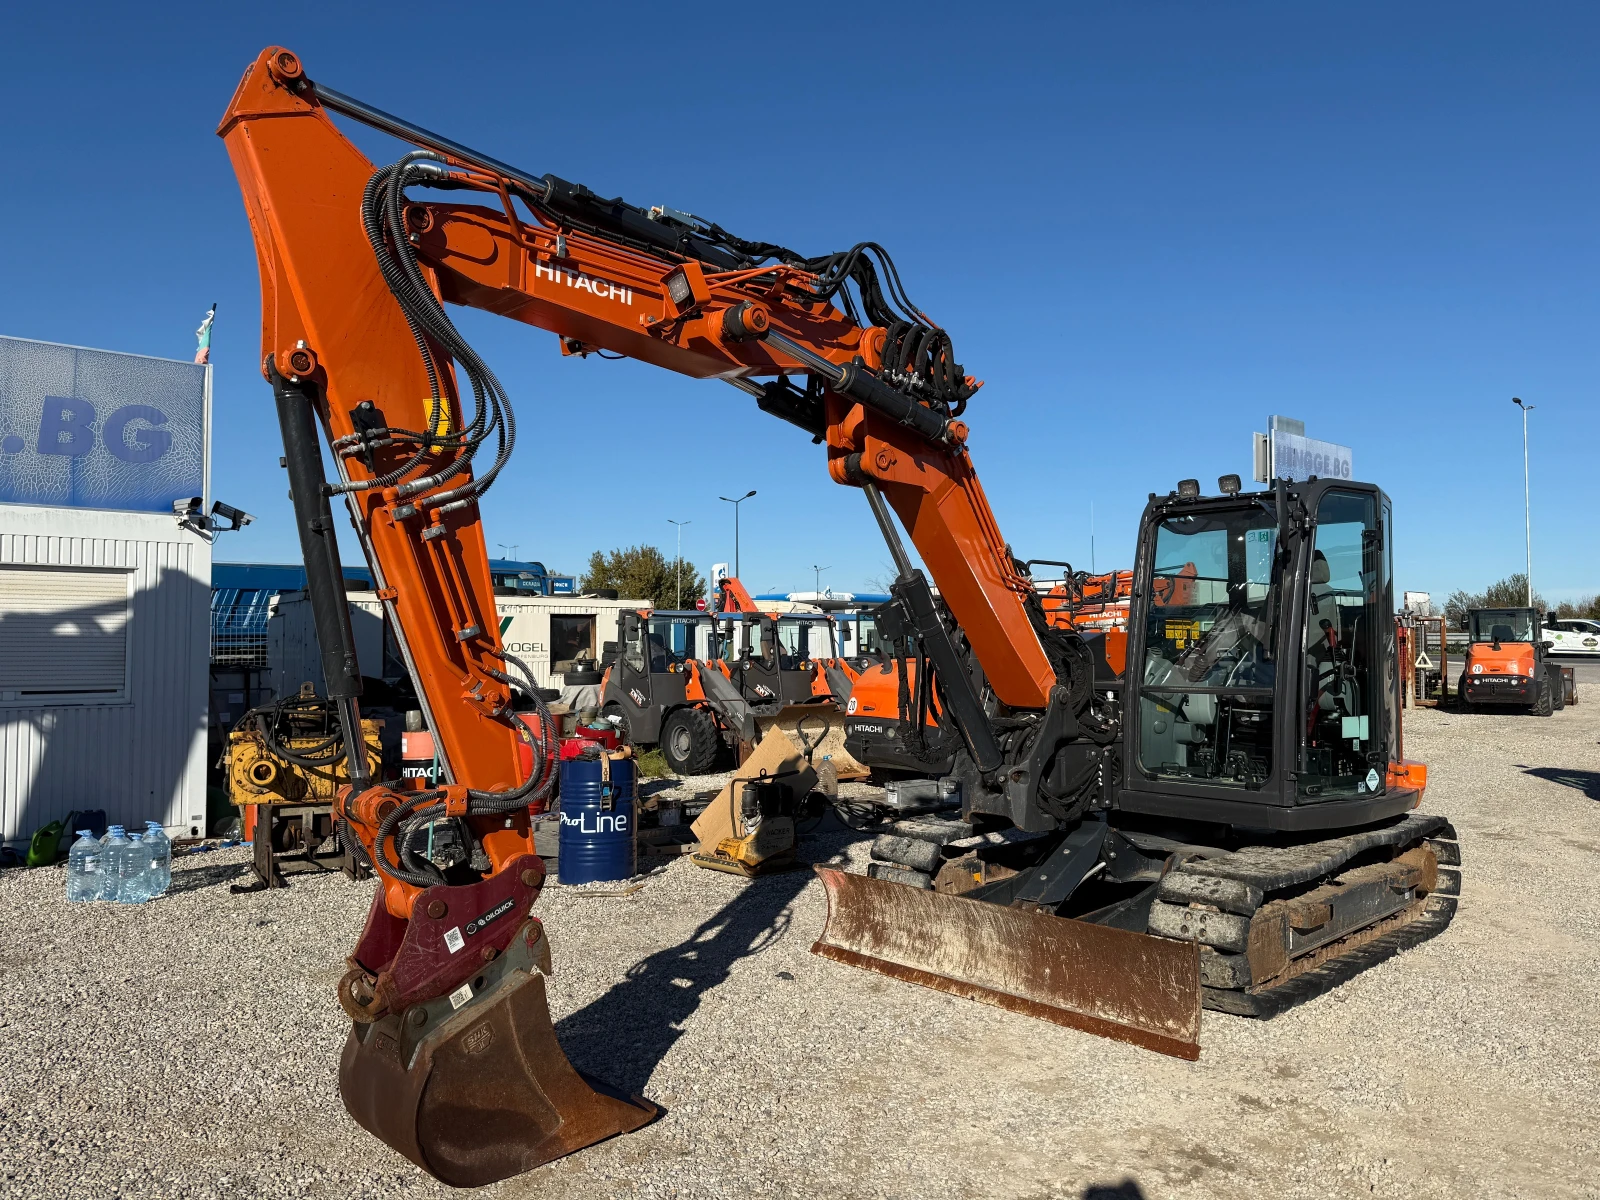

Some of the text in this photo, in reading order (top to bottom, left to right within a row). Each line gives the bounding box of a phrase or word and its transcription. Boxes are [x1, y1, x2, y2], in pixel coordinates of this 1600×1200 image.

[535, 258, 632, 306] HITACHI
[1089, 611, 1122, 619] HITACHI
[502, 642, 549, 652] VOGEL
[1473, 665, 1482, 673] 20
[848, 700, 857, 712] 20
[854, 724, 883, 734] HITACHI
[402, 766, 444, 778] HITACH
[485, 899, 515, 922] OILQUICK
